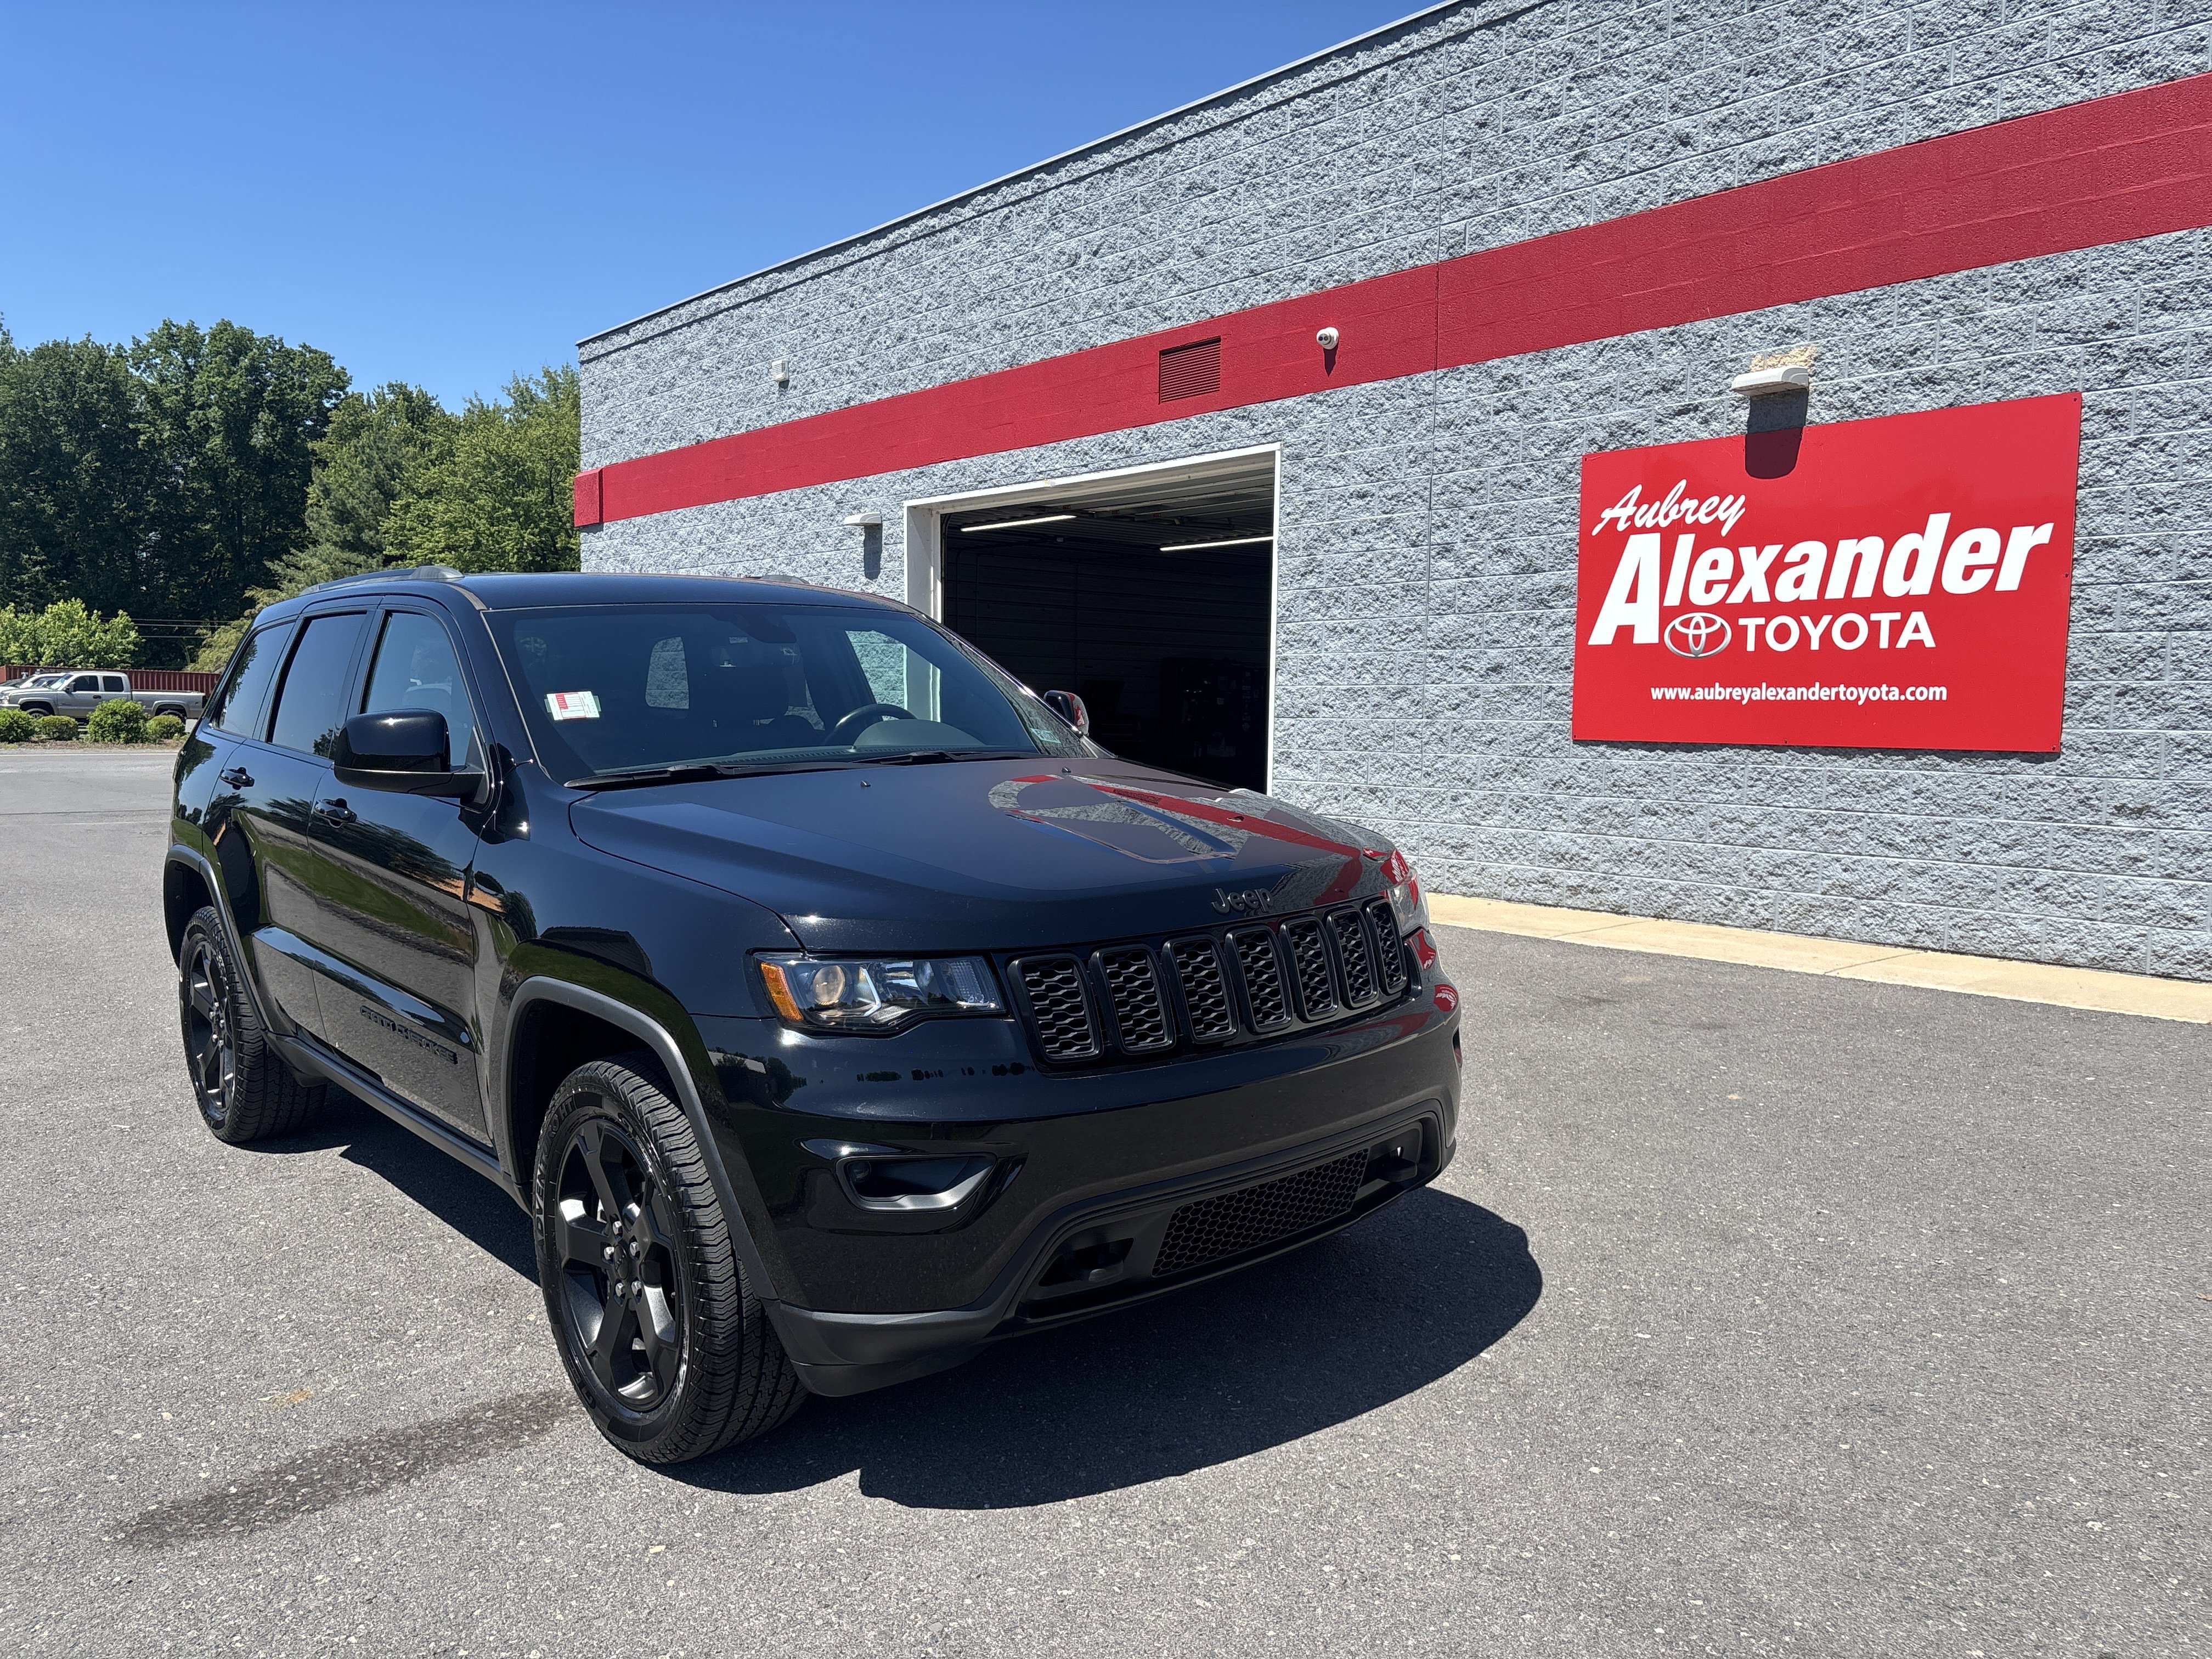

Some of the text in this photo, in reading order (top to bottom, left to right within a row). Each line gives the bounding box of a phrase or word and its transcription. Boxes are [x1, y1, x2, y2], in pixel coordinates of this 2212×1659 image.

[1592, 478, 1746, 537] Aubrey
[1587, 511, 2055, 646] Alexander
[1737, 611, 1937, 652] TOYOTA
[1650, 680, 1948, 706] www.aubreyalexandertoyota.com
[1211, 887, 1274, 915] Jeep
